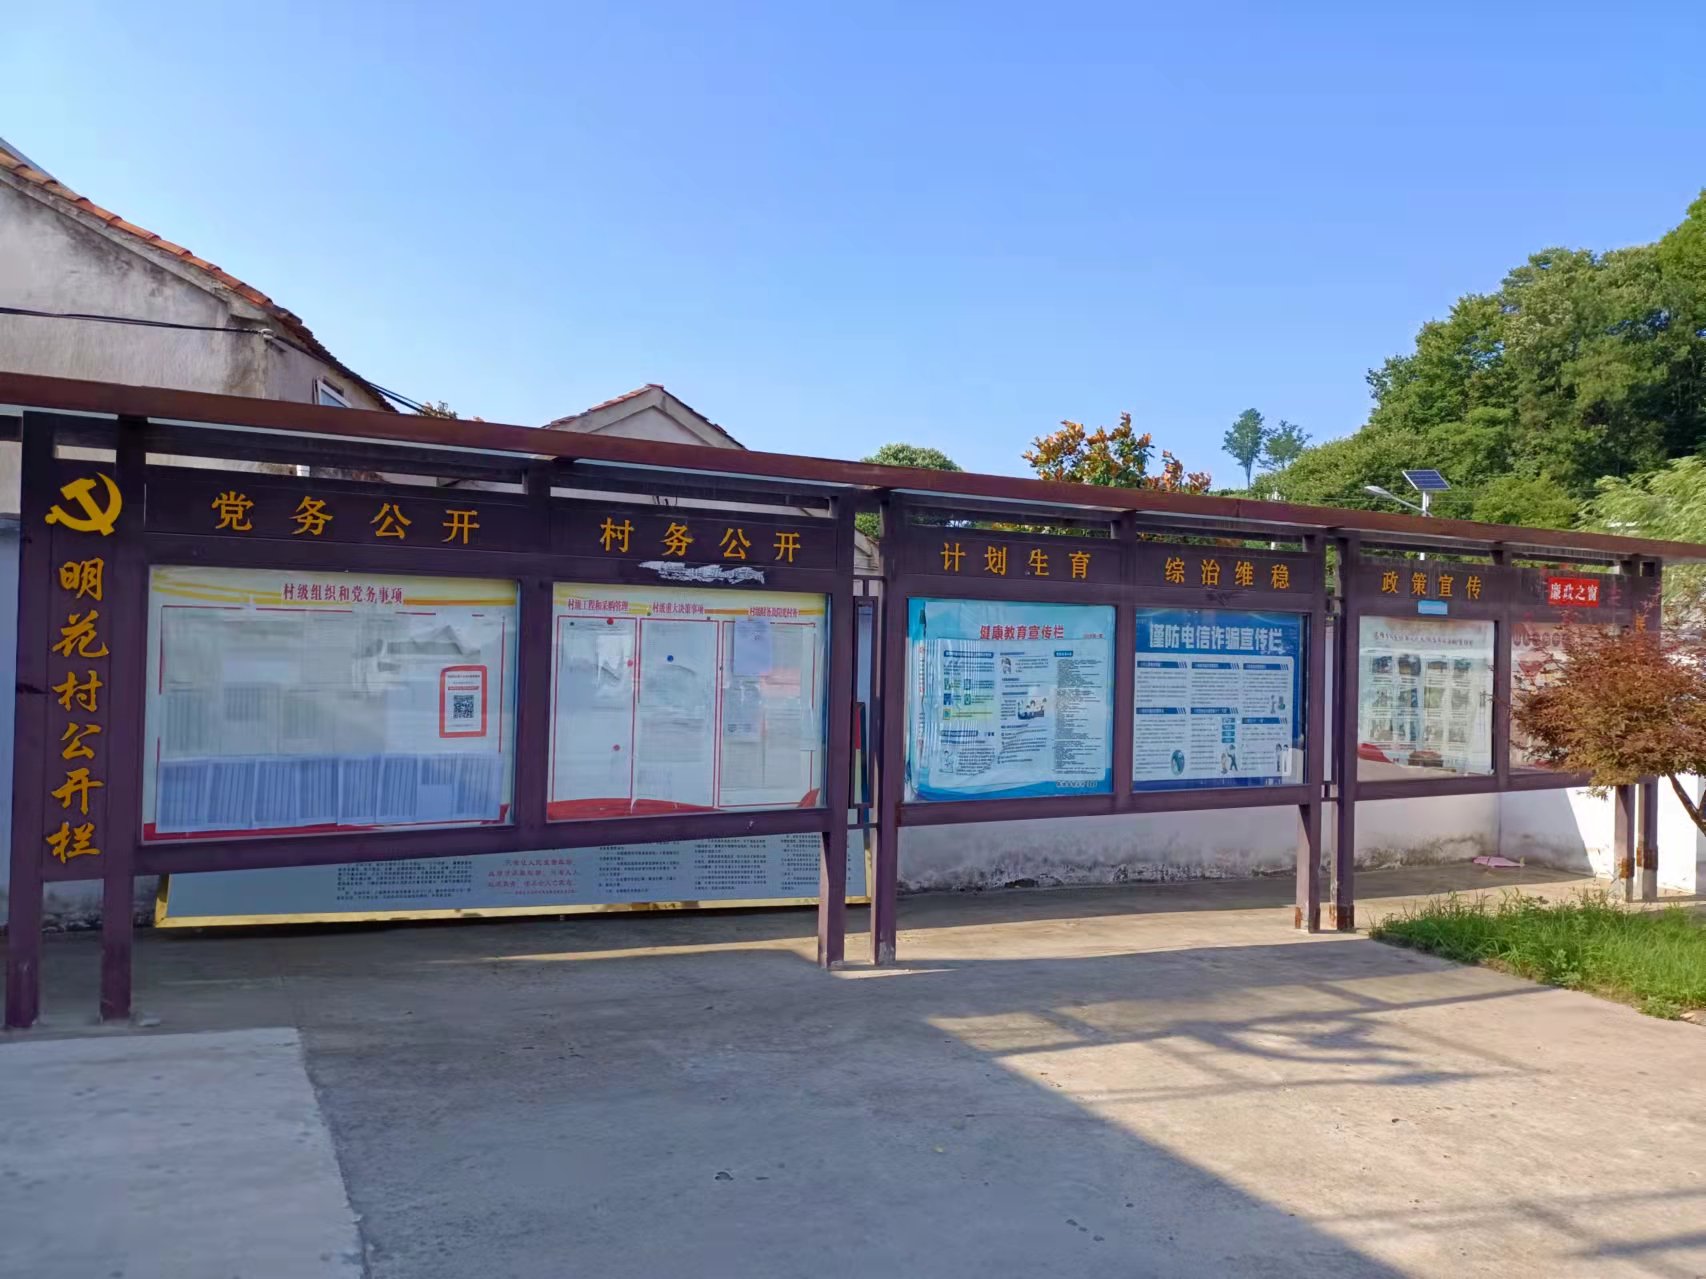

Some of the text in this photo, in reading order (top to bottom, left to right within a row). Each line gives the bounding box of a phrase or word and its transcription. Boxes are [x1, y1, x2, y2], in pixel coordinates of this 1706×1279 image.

[212, 491, 479, 544] 党务公开
[600, 517, 801, 562] 村务公开
[941, 543, 1090, 579] 计划生育
[1165, 557, 1290, 589] 综治维稳
[283, 583, 403, 604] 村级组织和党务事项
[1382, 571, 1482, 599] 政策宣传
[980, 624, 1064, 640] 健康教育宣传栏
[1149, 623, 1283, 651] 谨防电信诈骗宣传栏
[46, 558, 110, 863] 明花村公开栏
